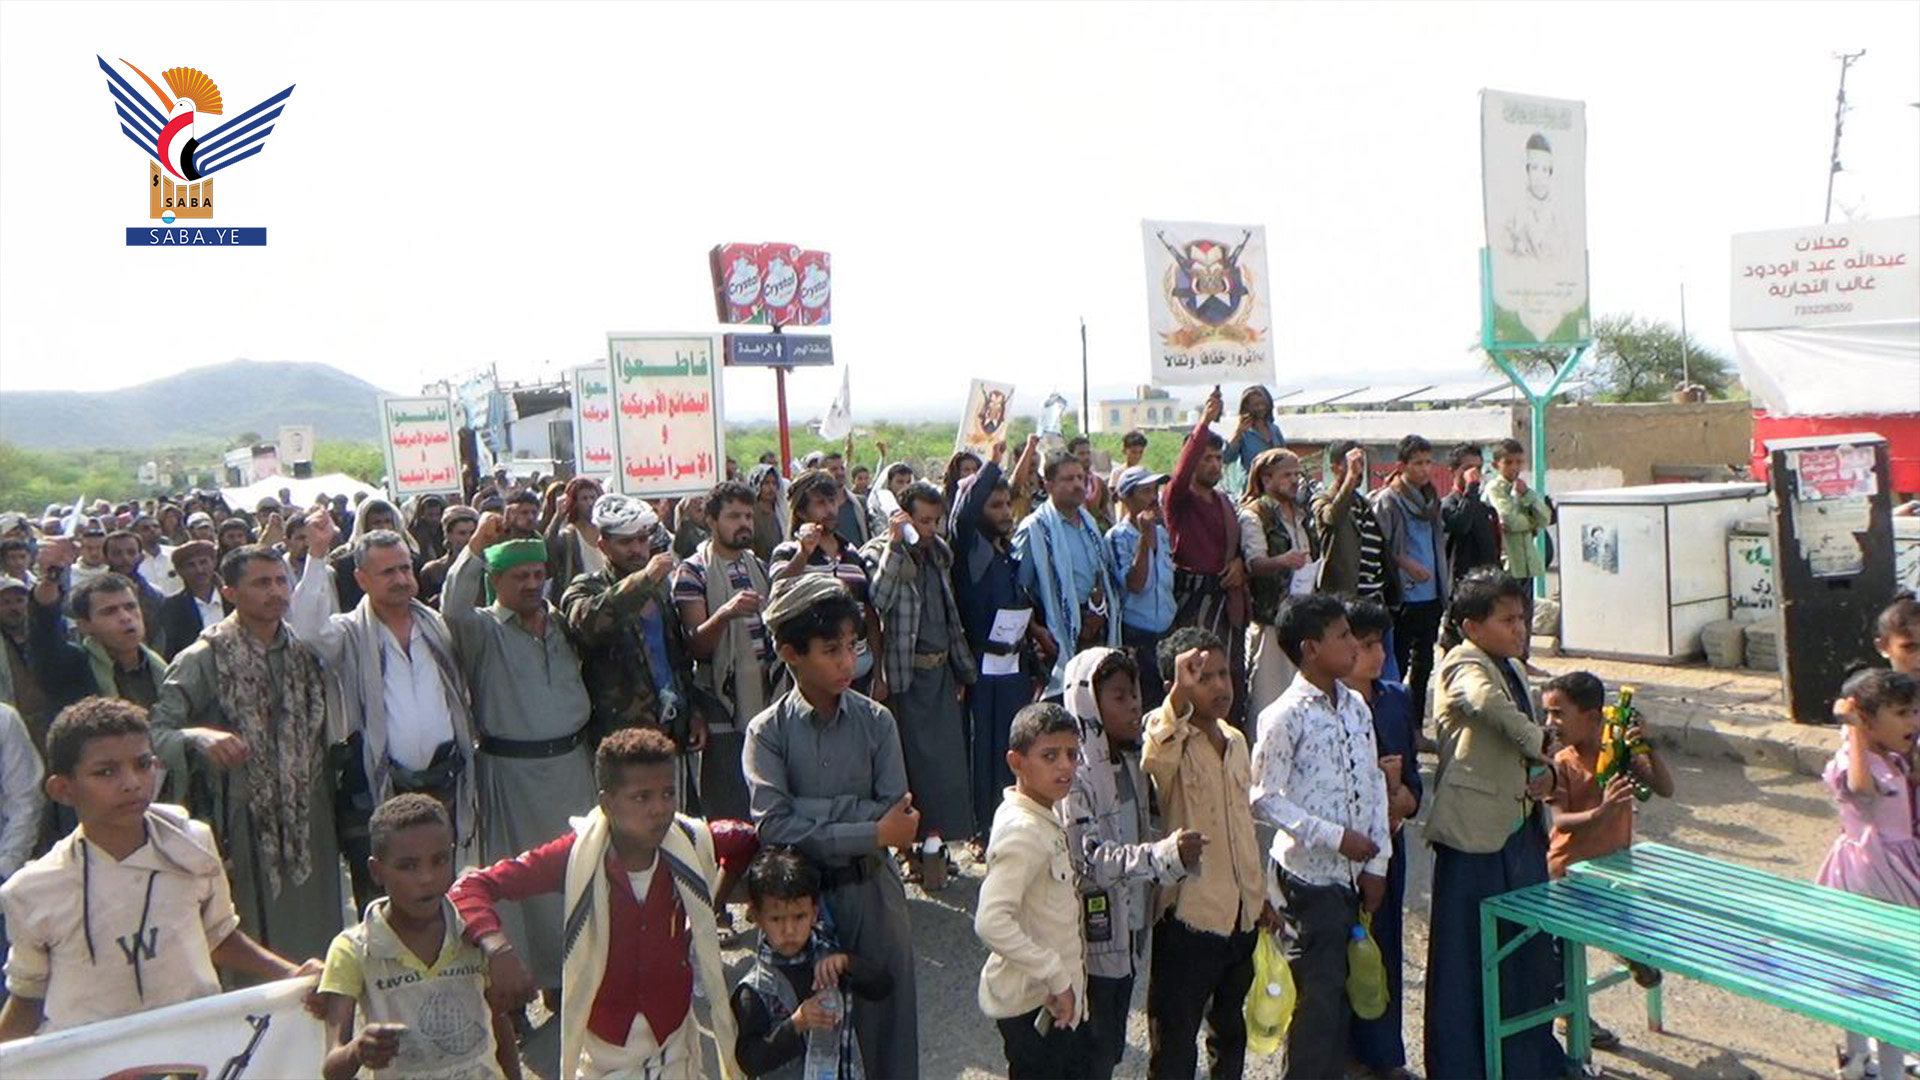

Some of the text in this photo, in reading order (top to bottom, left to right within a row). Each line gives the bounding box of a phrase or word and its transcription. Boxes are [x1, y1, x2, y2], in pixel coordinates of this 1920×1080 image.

[1795, 236, 1849, 252] محلات
[1743, 251, 1906, 279] عبدالله عبد الودود
[1835, 276, 1876, 292] غالب
[617, 351, 708, 383] قاطعوا
[620, 389, 710, 419] البضائع الأمريكية
[661, 424, 669, 445] و
[626, 452, 713, 482] الإسرائيلية
[116, 927, 159, 965] W
